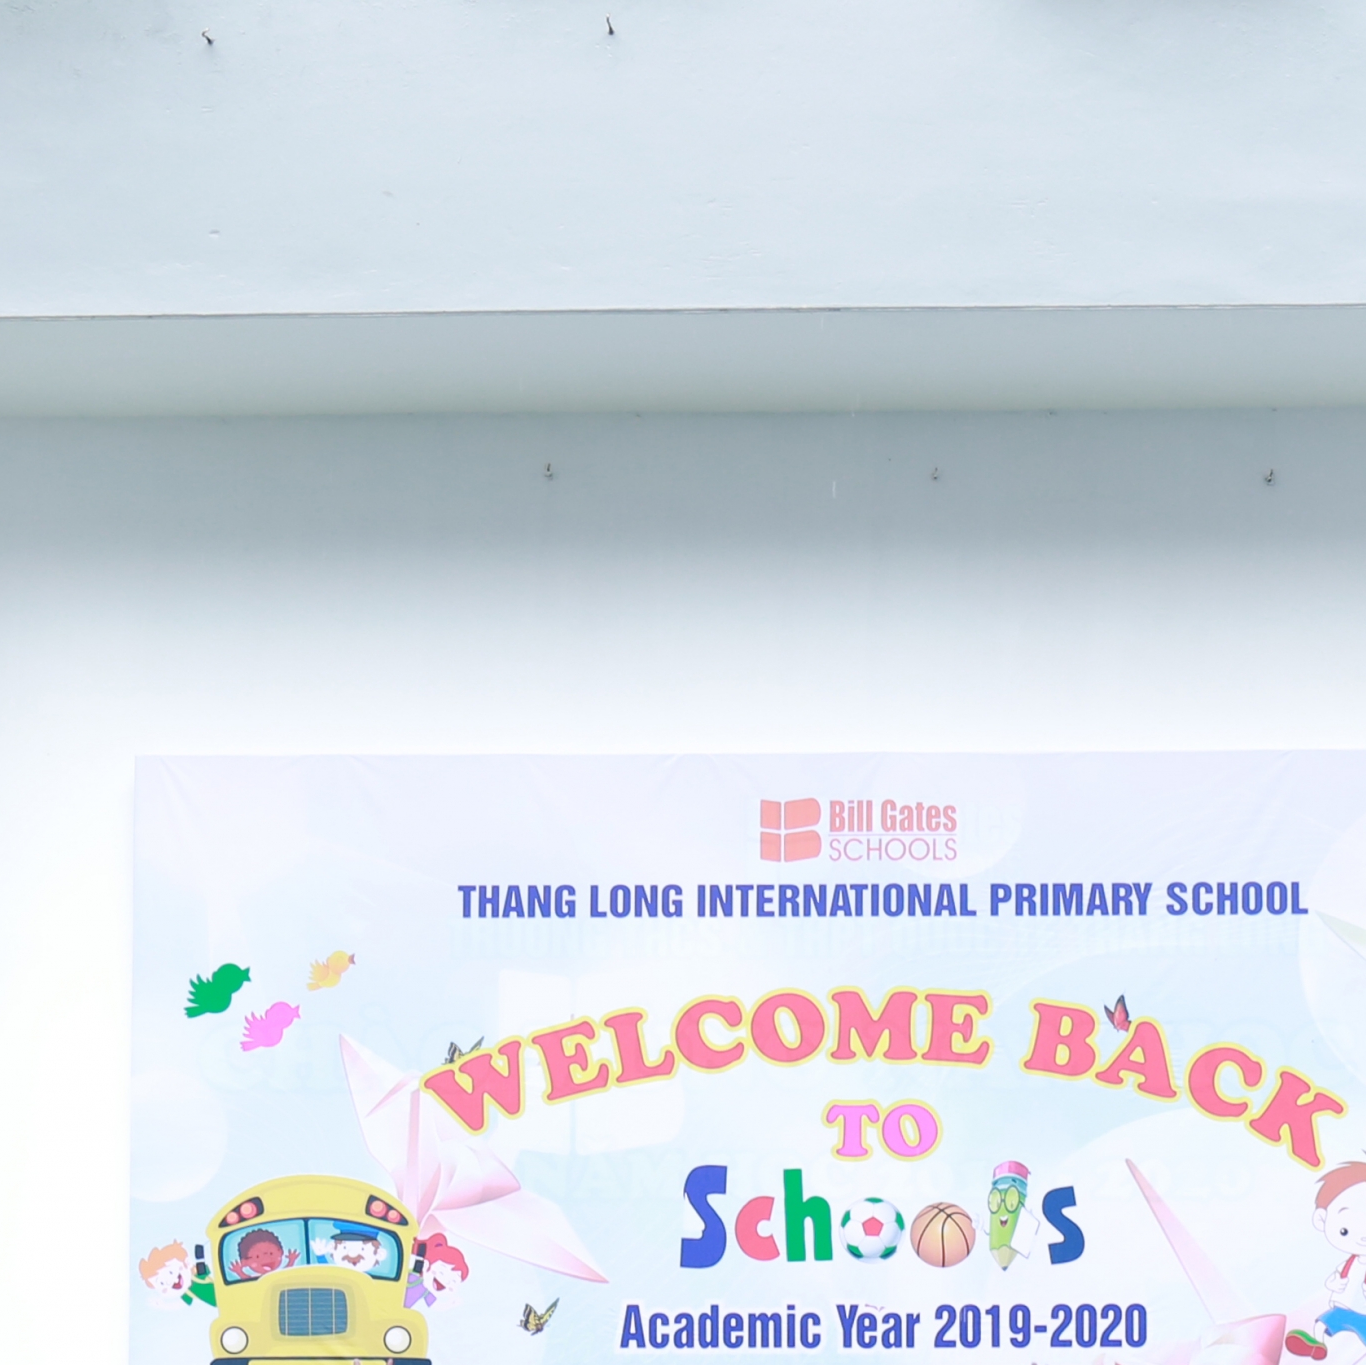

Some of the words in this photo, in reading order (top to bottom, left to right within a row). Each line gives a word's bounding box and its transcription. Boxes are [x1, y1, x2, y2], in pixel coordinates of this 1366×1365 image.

[829, 799, 873, 833] Bill
[880, 798, 958, 833] Gates
[828, 837, 958, 862] SCHOOLS
[457, 884, 577, 919] THANG
[589, 884, 684, 919] LONG
[696, 883, 977, 918] INTERNATIONAL
[989, 881, 1153, 917] PRIMARY
[1165, 880, 1309, 916] SCHOOL
[421, 987, 993, 1134] WELCOME
[1021, 1000, 1346, 1169] BACK
[825, 1101, 940, 1159] TO
[619, 1303, 823, 1350] Academic
[835, 1303, 921, 1350] Year
[933, 1303, 1149, 1349] 2019-2020
